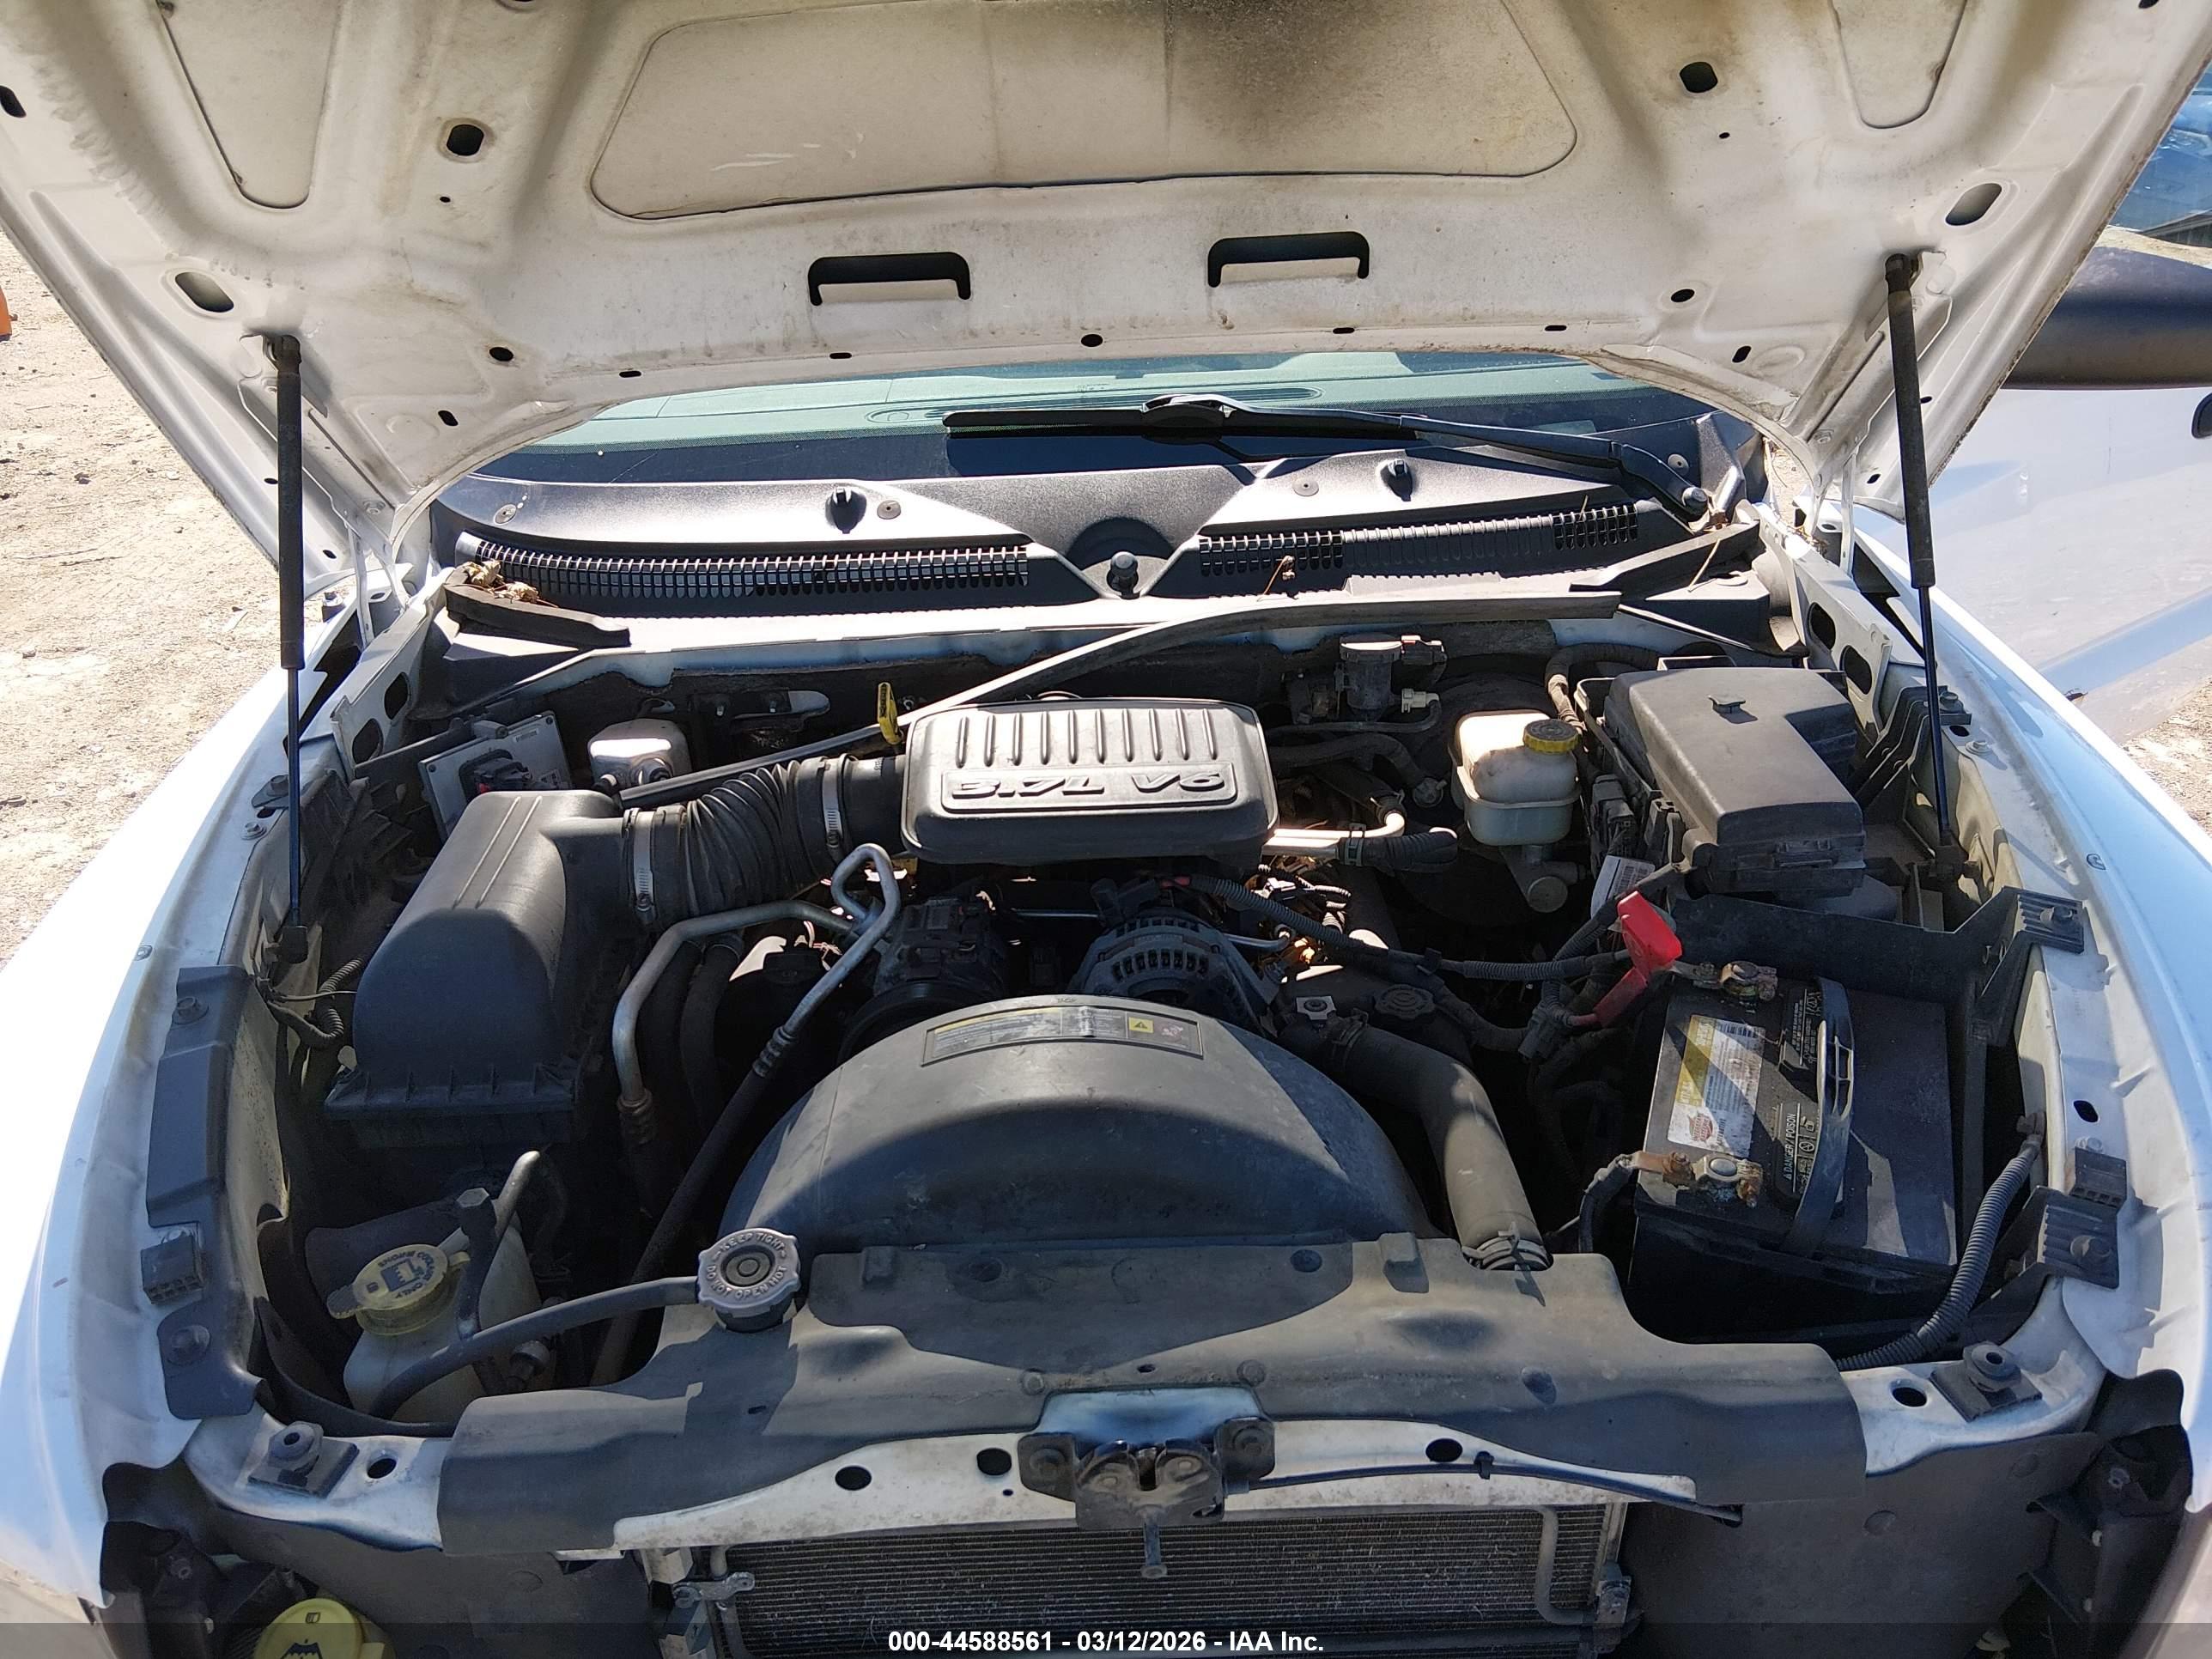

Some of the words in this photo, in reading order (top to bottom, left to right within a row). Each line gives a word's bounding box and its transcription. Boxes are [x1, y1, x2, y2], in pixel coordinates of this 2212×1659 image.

[951, 775, 1105, 799] 3.7L
[1131, 771, 1225, 793] V6
[1785, 1113, 1796, 1138] POISON
[1784, 1144, 1795, 1173] DANGER
[720, 1232, 752, 1252] KEEP
[756, 1232, 786, 1250] TIGHT
[707, 1265, 716, 1279] DO
[734, 1284, 769, 1299] OPEN
[769, 1266, 787, 1285] HOT
